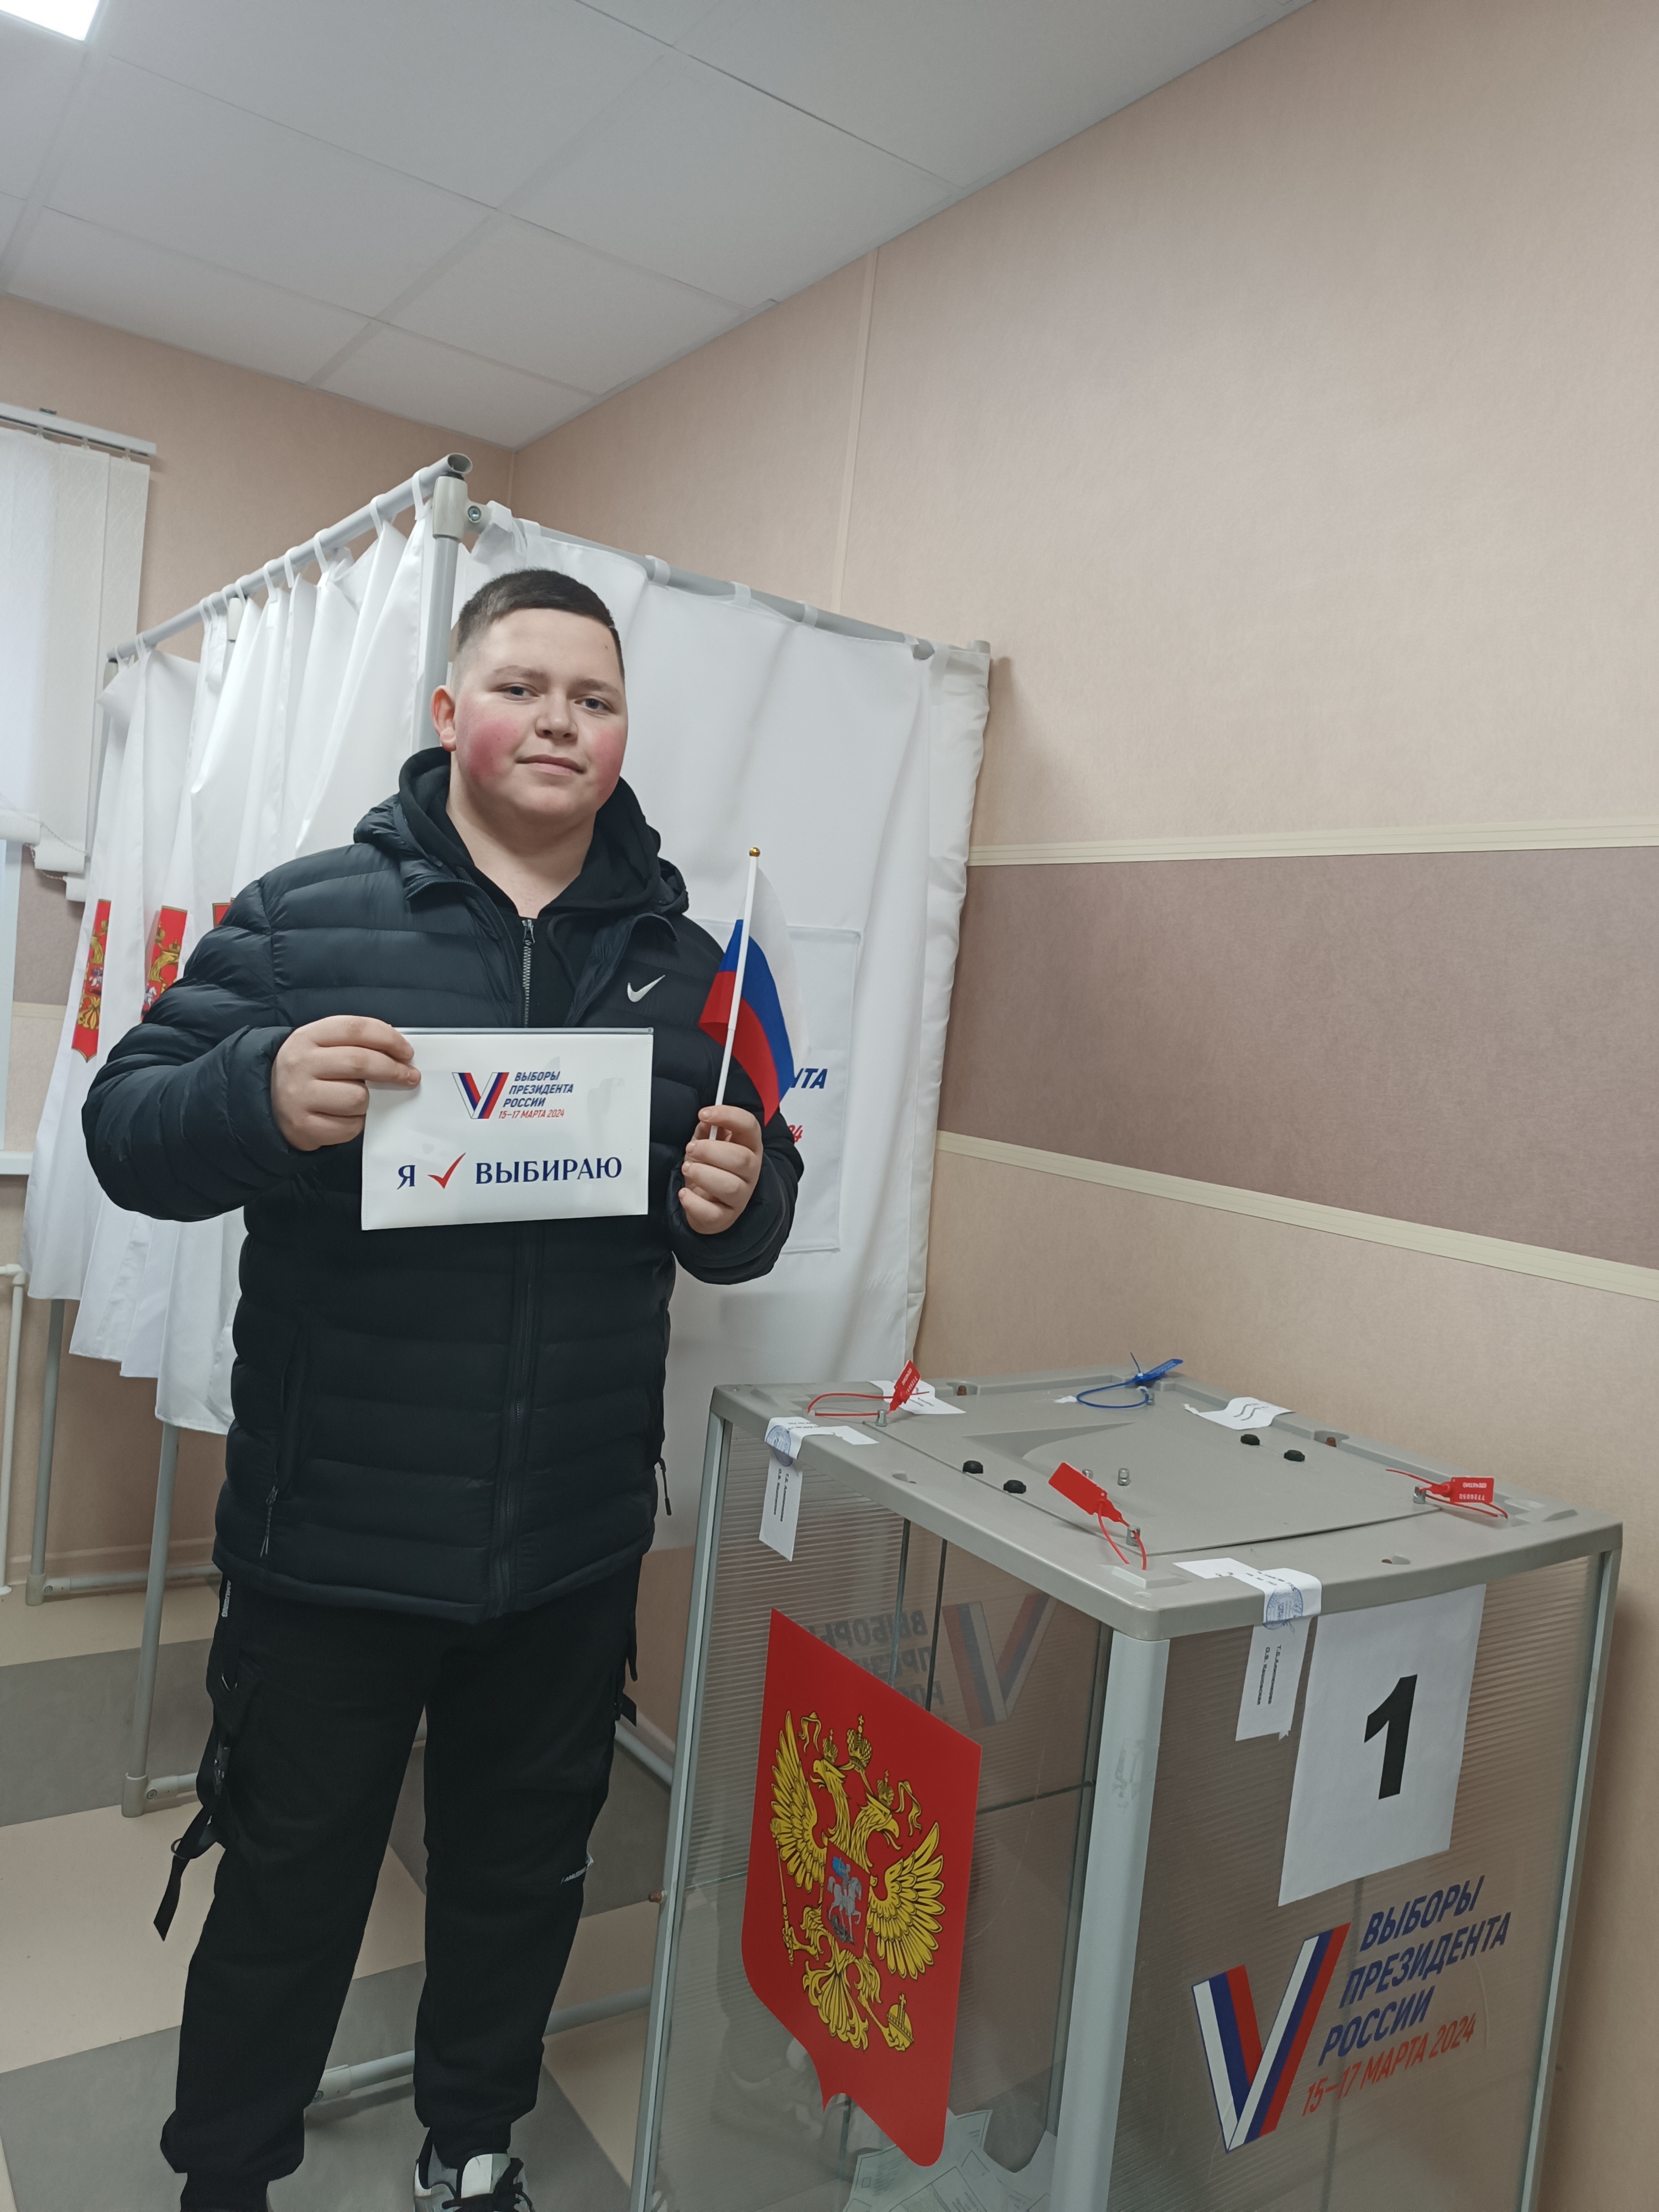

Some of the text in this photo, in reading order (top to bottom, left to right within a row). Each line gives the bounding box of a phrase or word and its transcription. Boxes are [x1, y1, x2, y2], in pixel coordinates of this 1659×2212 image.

[503, 1098, 546, 1108] РОССИИ
[509, 1084, 573, 1095] ПРЕЗИДЕНТА
[514, 1071, 560, 1081] ВЫБОРЫ
[547, 1109, 565, 1118] 2024
[397, 1157, 622, 1190] Я ВЫБИРАЮ
[1364, 1673, 1418, 1800] 1
[1359, 1875, 1485, 1952] ВЫБОРЫ
[1338, 1912, 1511, 2009] ПРЕЗИДЕНТА
[1318, 1985, 1436, 2067] РОССИИ
[1359, 2032, 1429, 2090] МАРТА
[1428, 2012, 1477, 2059] 2024
